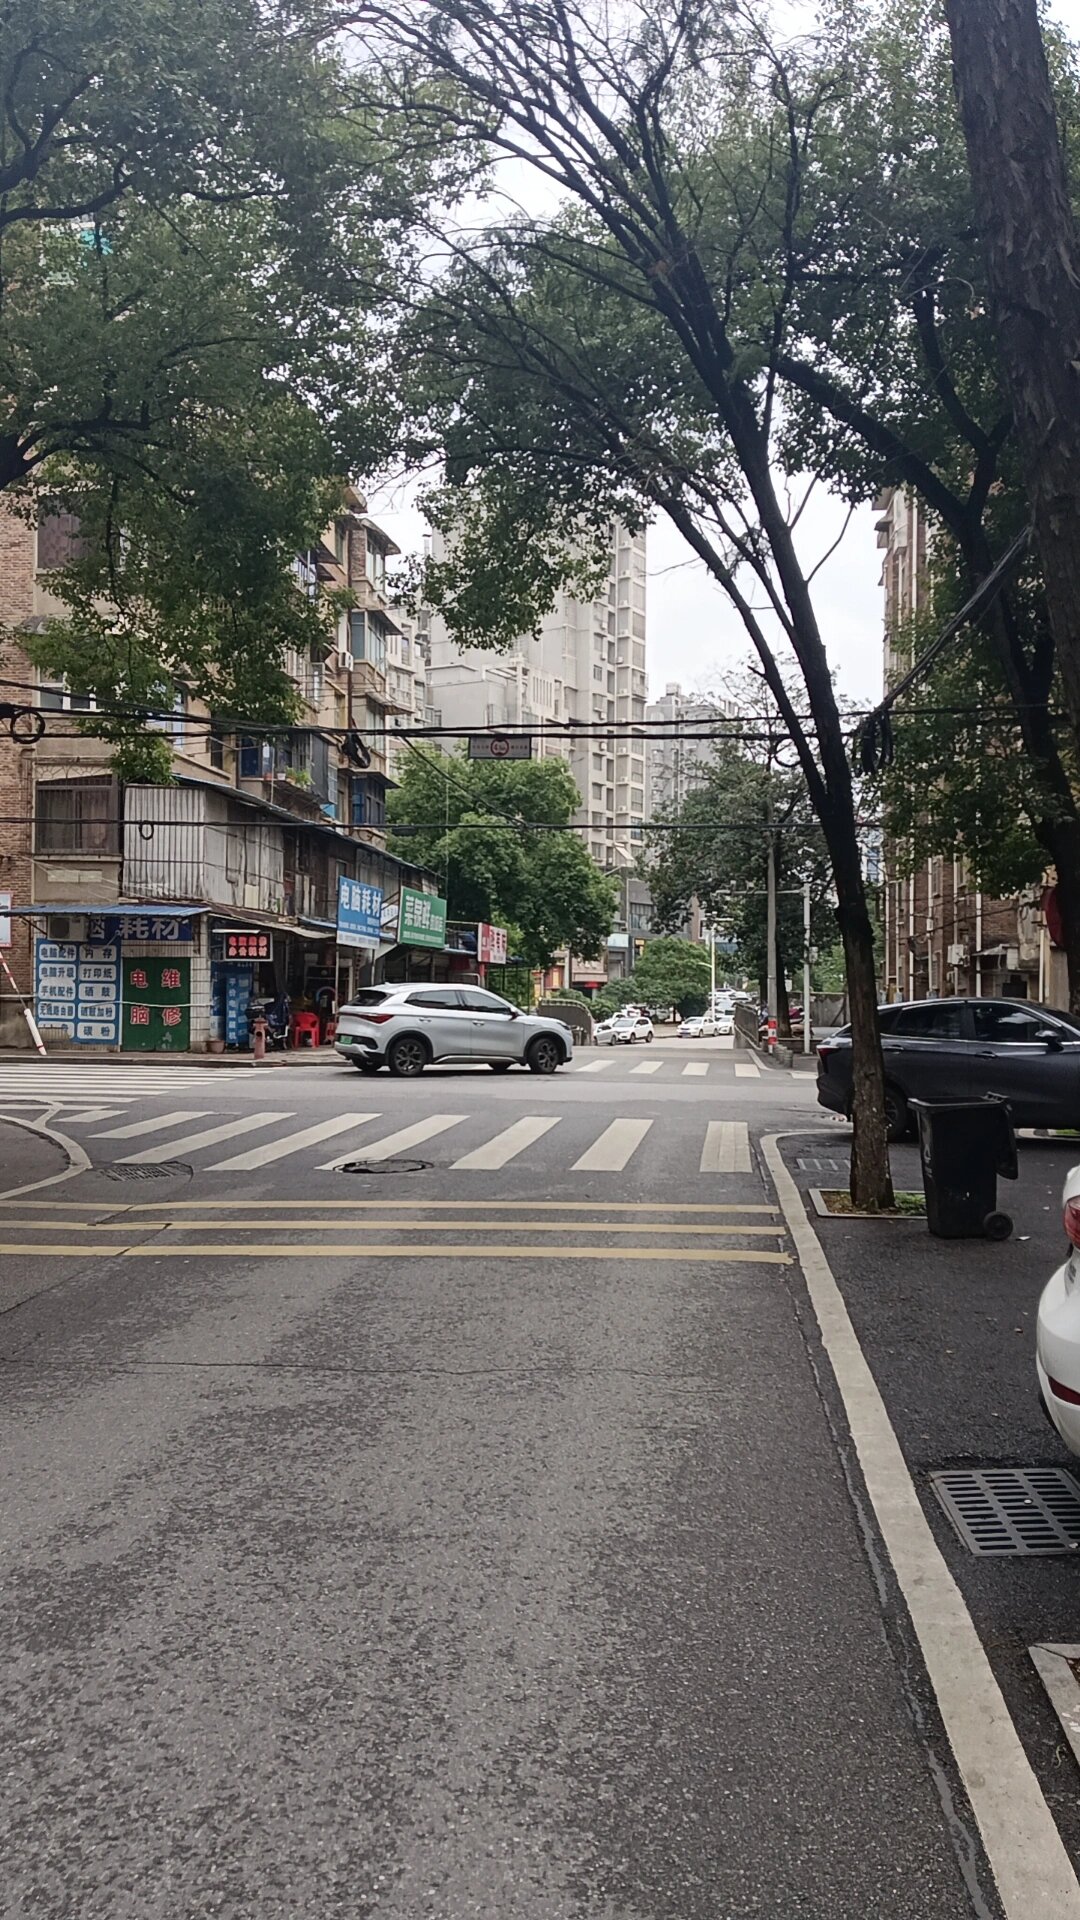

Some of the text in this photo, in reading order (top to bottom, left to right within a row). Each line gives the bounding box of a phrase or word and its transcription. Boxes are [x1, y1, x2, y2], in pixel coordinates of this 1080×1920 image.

[341, 881, 382, 918] 电脑耗材
[41, 947, 75, 958] 电脑配件
[41, 967, 74, 978] 电脑升级
[83, 968, 112, 979] 打印纸
[41, 986, 73, 997] 手机配件
[40, 1004, 74, 1016] 无线路由器
